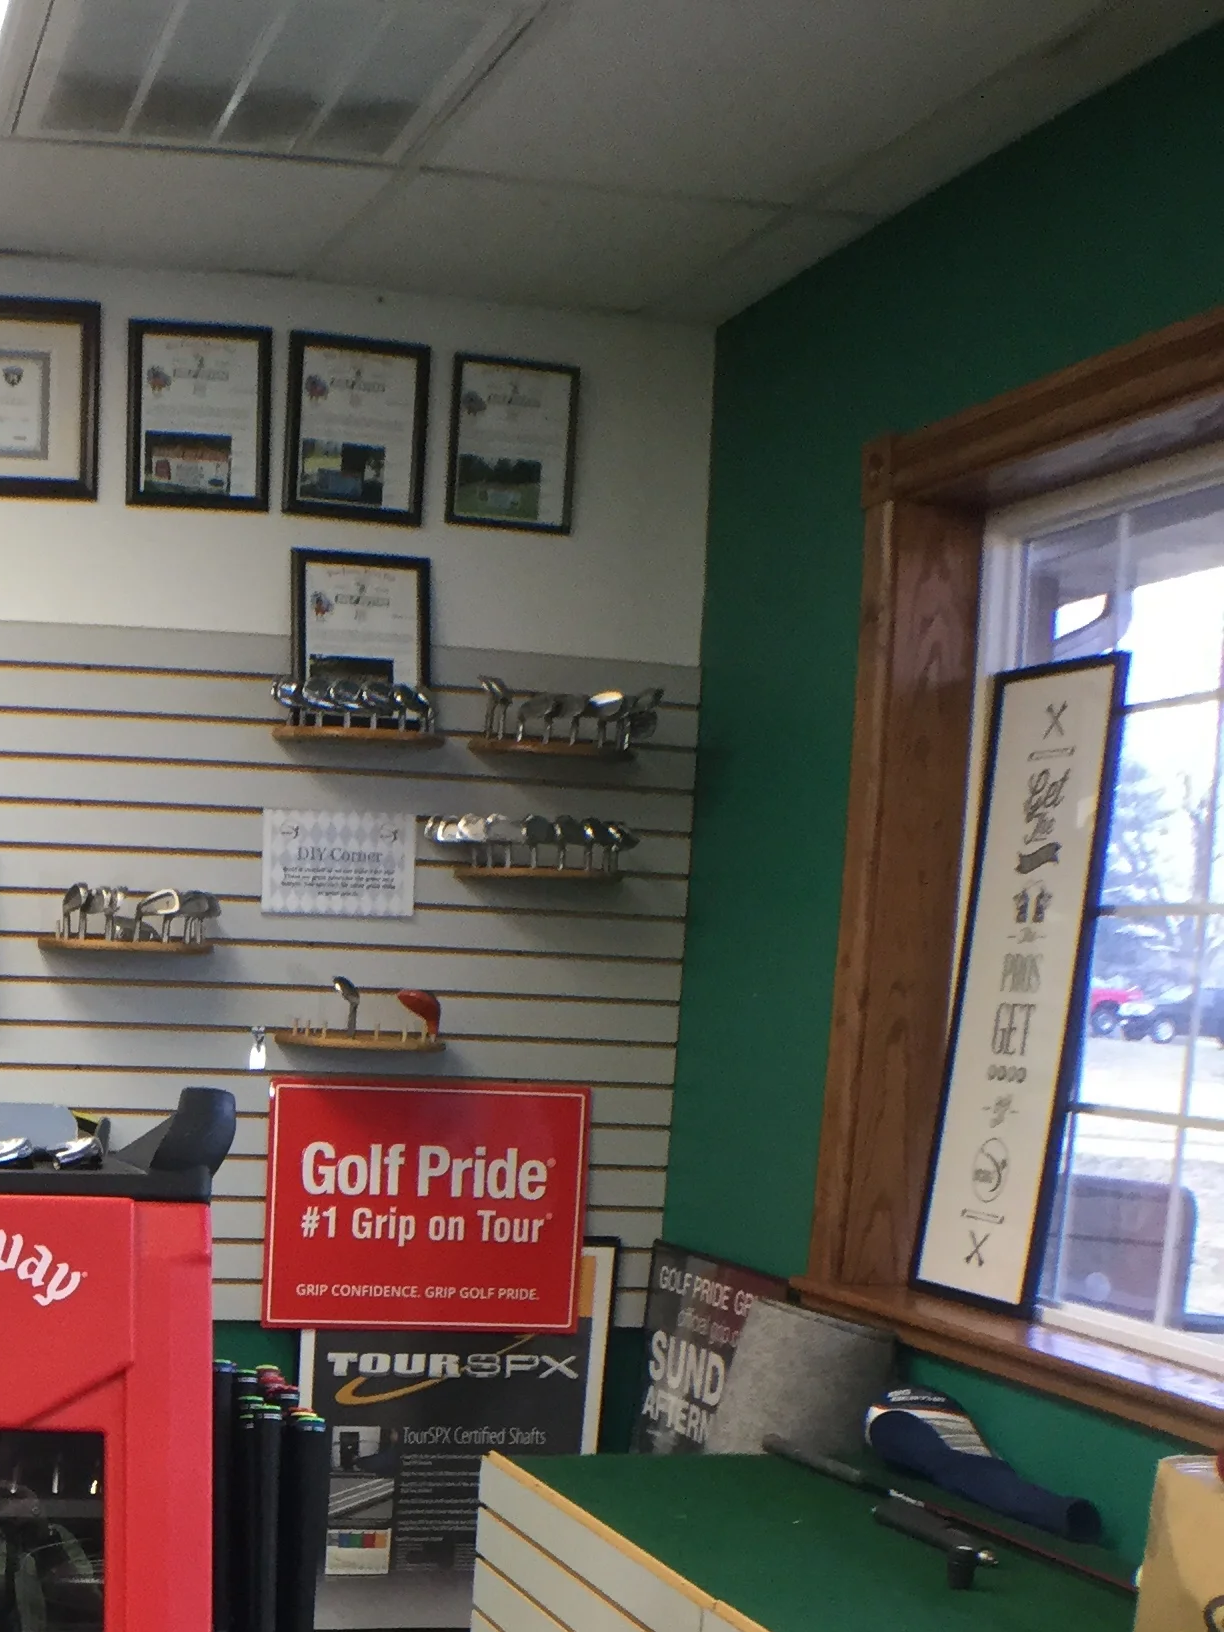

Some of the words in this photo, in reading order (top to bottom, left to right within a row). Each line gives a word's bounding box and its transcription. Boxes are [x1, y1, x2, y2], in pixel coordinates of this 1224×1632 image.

[296, 846, 326, 862] DIY
[330, 847, 384, 864] Corner
[990, 1001, 1037, 1057] GET
[301, 1140, 406, 1197] Golf
[417, 1144, 548, 1201] Pride
[301, 1206, 338, 1239] #1
[351, 1206, 416, 1247] Grip
[428, 1213, 465, 1242] on
[476, 1209, 545, 1243] Tour
[295, 1283, 329, 1297] GRIP
[330, 1283, 421, 1299] CONFIDENCE.
[424, 1285, 457, 1299] GRIP
[458, 1286, 495, 1300] GOLF
[497, 1287, 540, 1301] PRIDE.
[658, 1265, 693, 1297] GOLF
[692, 1274, 734, 1311] PRIDE
[648, 1329, 725, 1407] SUND
[402, 1425, 451, 1445] TourSPX
[453, 1426, 507, 1446] Certified
[509, 1426, 546, 1446] Shafts
